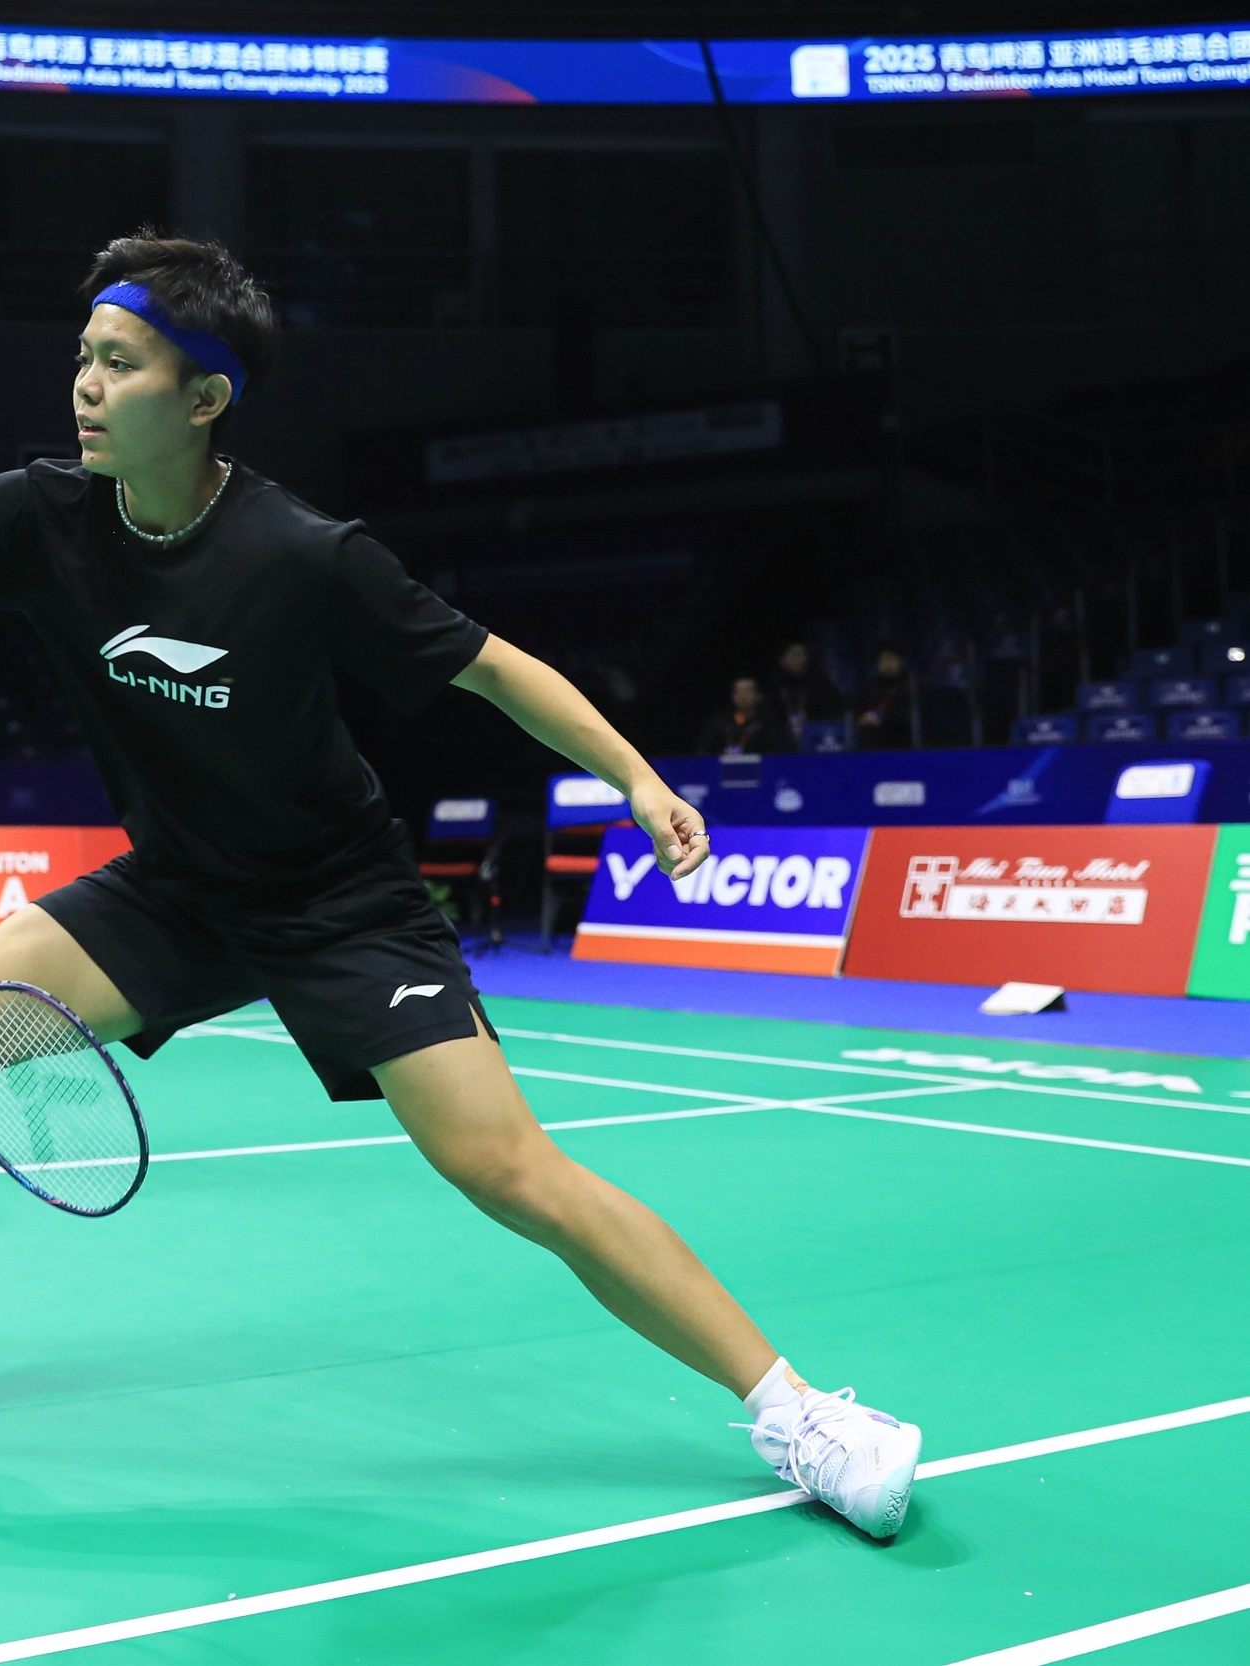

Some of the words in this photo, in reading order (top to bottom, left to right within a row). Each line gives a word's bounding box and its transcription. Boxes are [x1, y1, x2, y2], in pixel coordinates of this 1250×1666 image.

[863, 44, 937, 73] 2025
[84, 66, 121, 86] Asia
[122, 68, 175, 88] Mixed
[176, 70, 221, 91] Team
[222, 70, 343, 96] Championship
[947, 71, 1043, 92] Badminton
[1043, 69, 1083, 88] Asia
[1082, 66, 1138, 87] Mixed
[1139, 65, 1187, 84] Team
[109, 662, 230, 709] LI-NING
